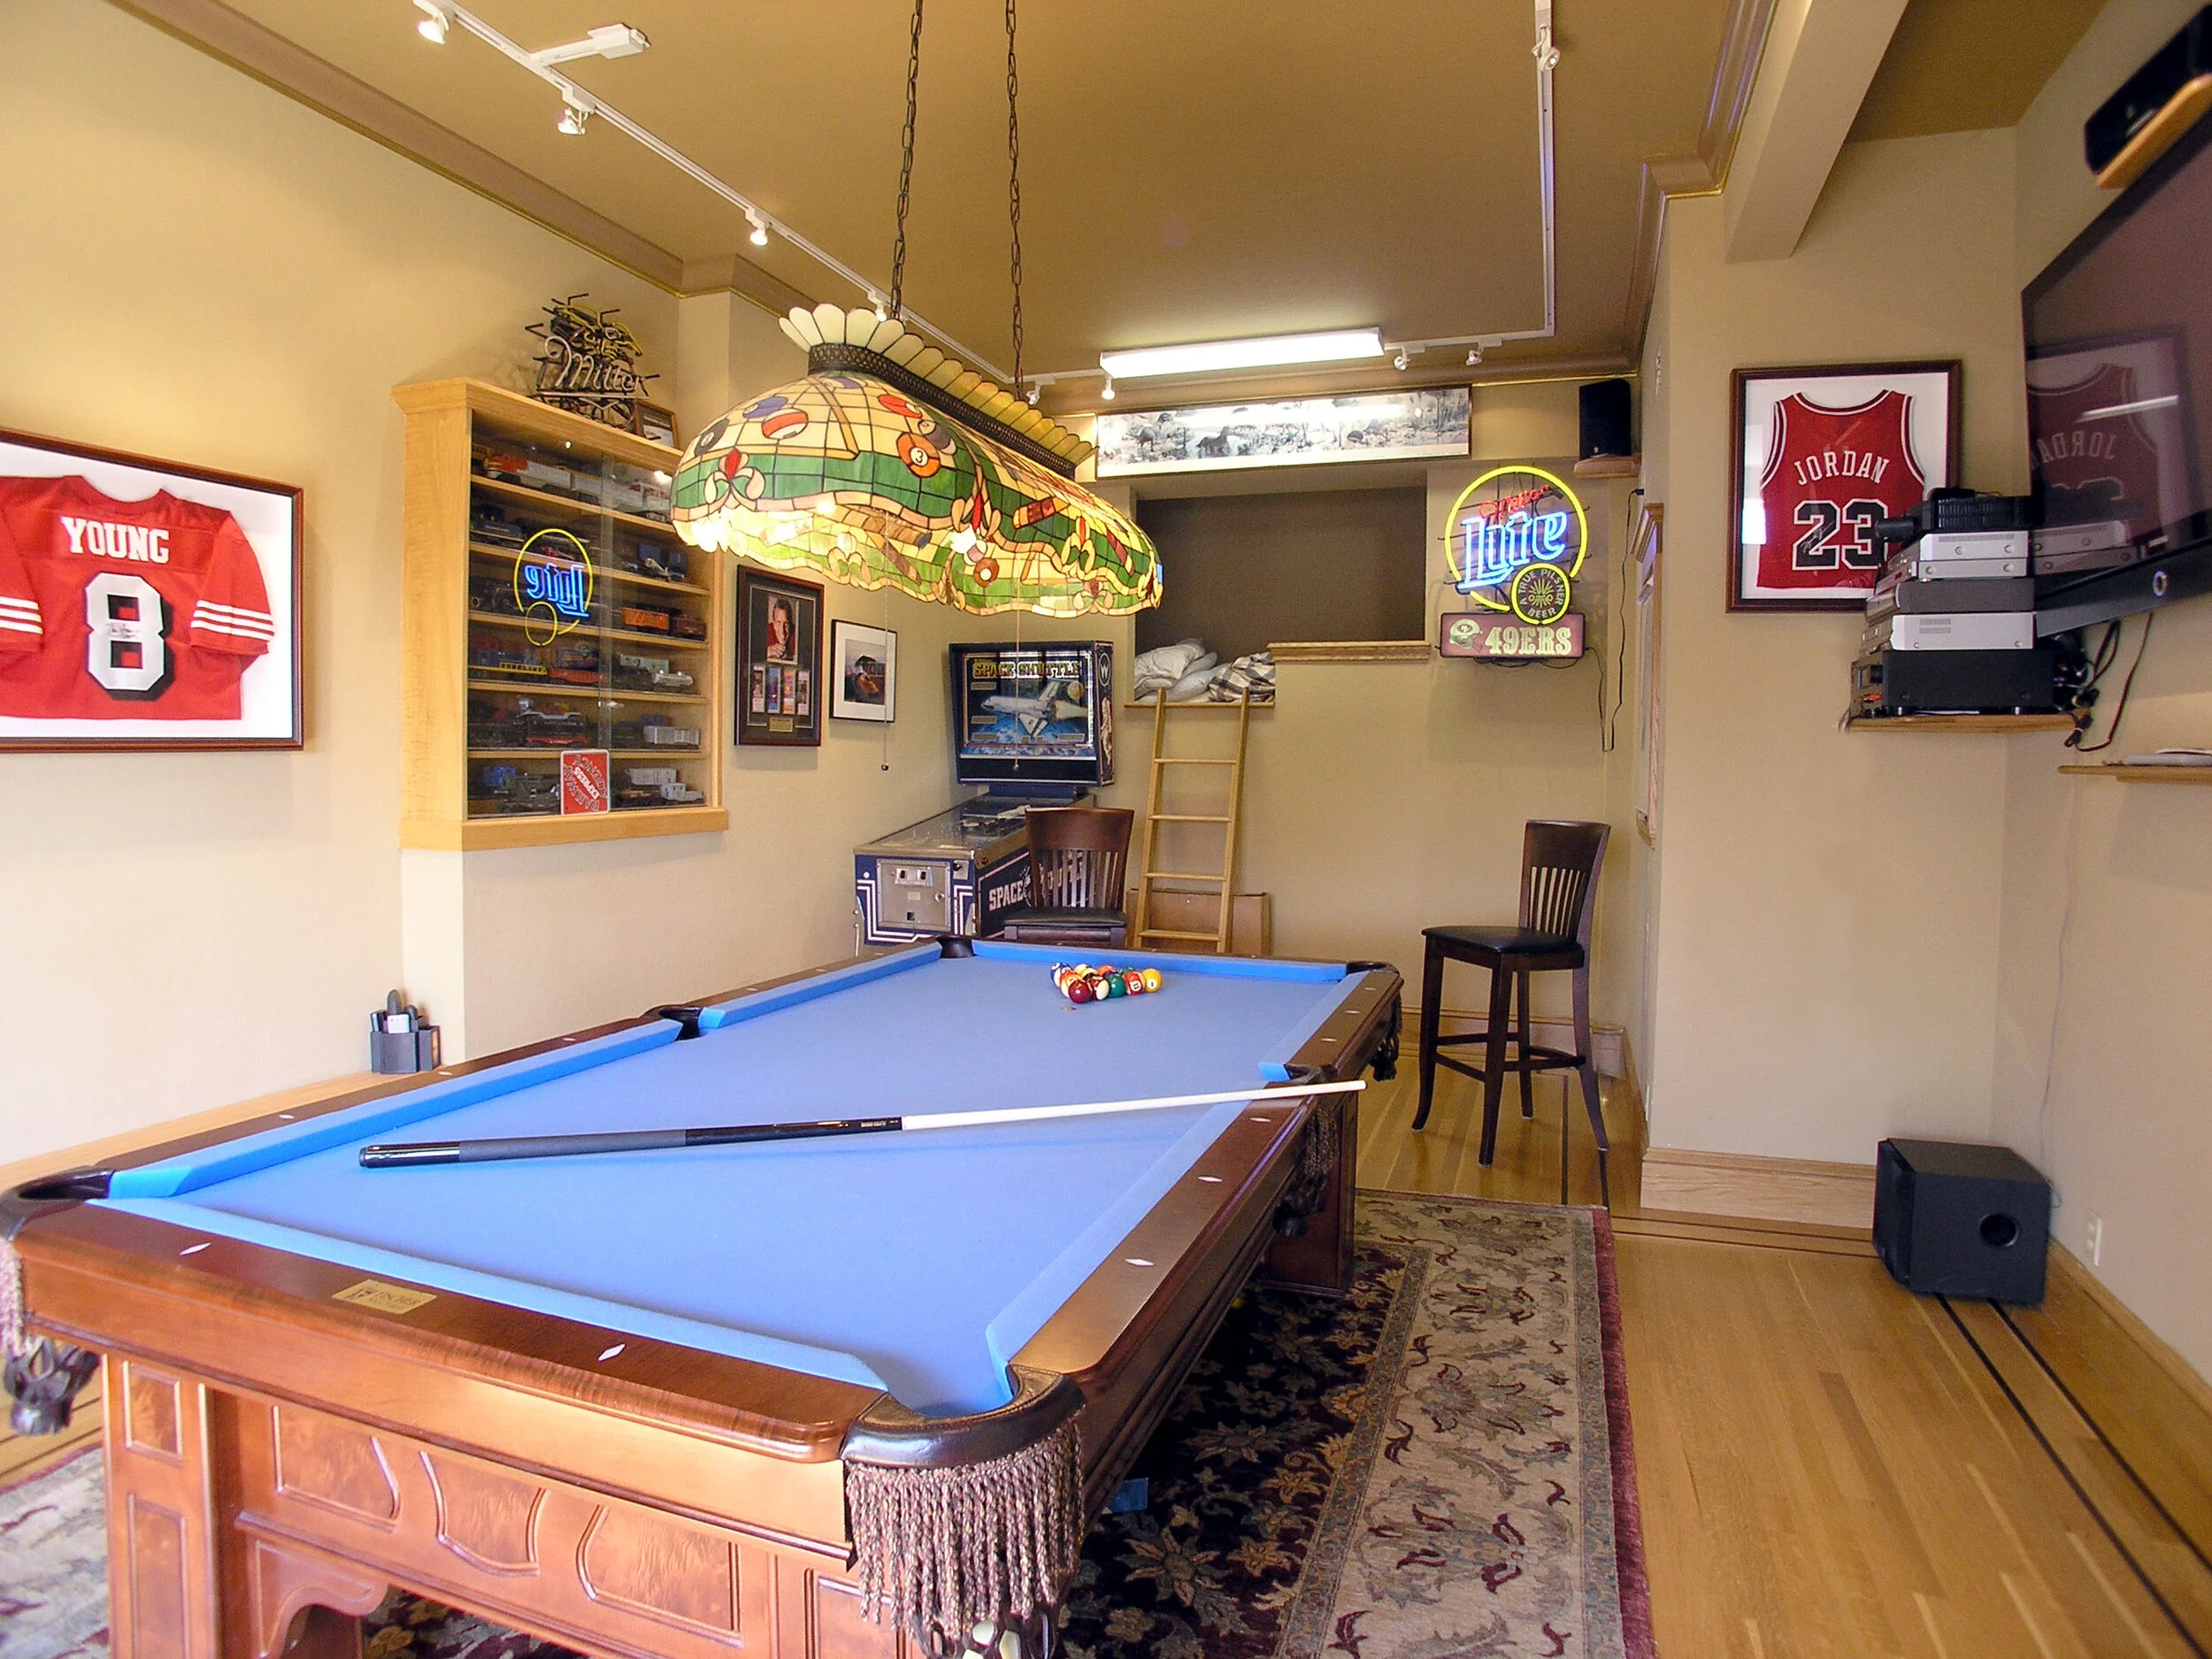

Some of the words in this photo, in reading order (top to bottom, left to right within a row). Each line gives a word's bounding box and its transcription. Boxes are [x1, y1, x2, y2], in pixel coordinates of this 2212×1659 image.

[915, 449, 924, 464] 3
[1793, 450, 1889, 486] JORDAN
[61, 516, 169, 565] YOUNG
[1457, 511, 1567, 589] Lite
[1792, 498, 1888, 571] 23
[1518, 571, 1537, 593] TRUE
[1540, 569, 1564, 605] PILSNER
[1527, 607, 1556, 618] BEER
[84, 572, 170, 695] 8
[1485, 626, 1572, 656] 49ERS
[973, 662, 1016, 679] SPACE
[989, 880, 1024, 912] SPACE
